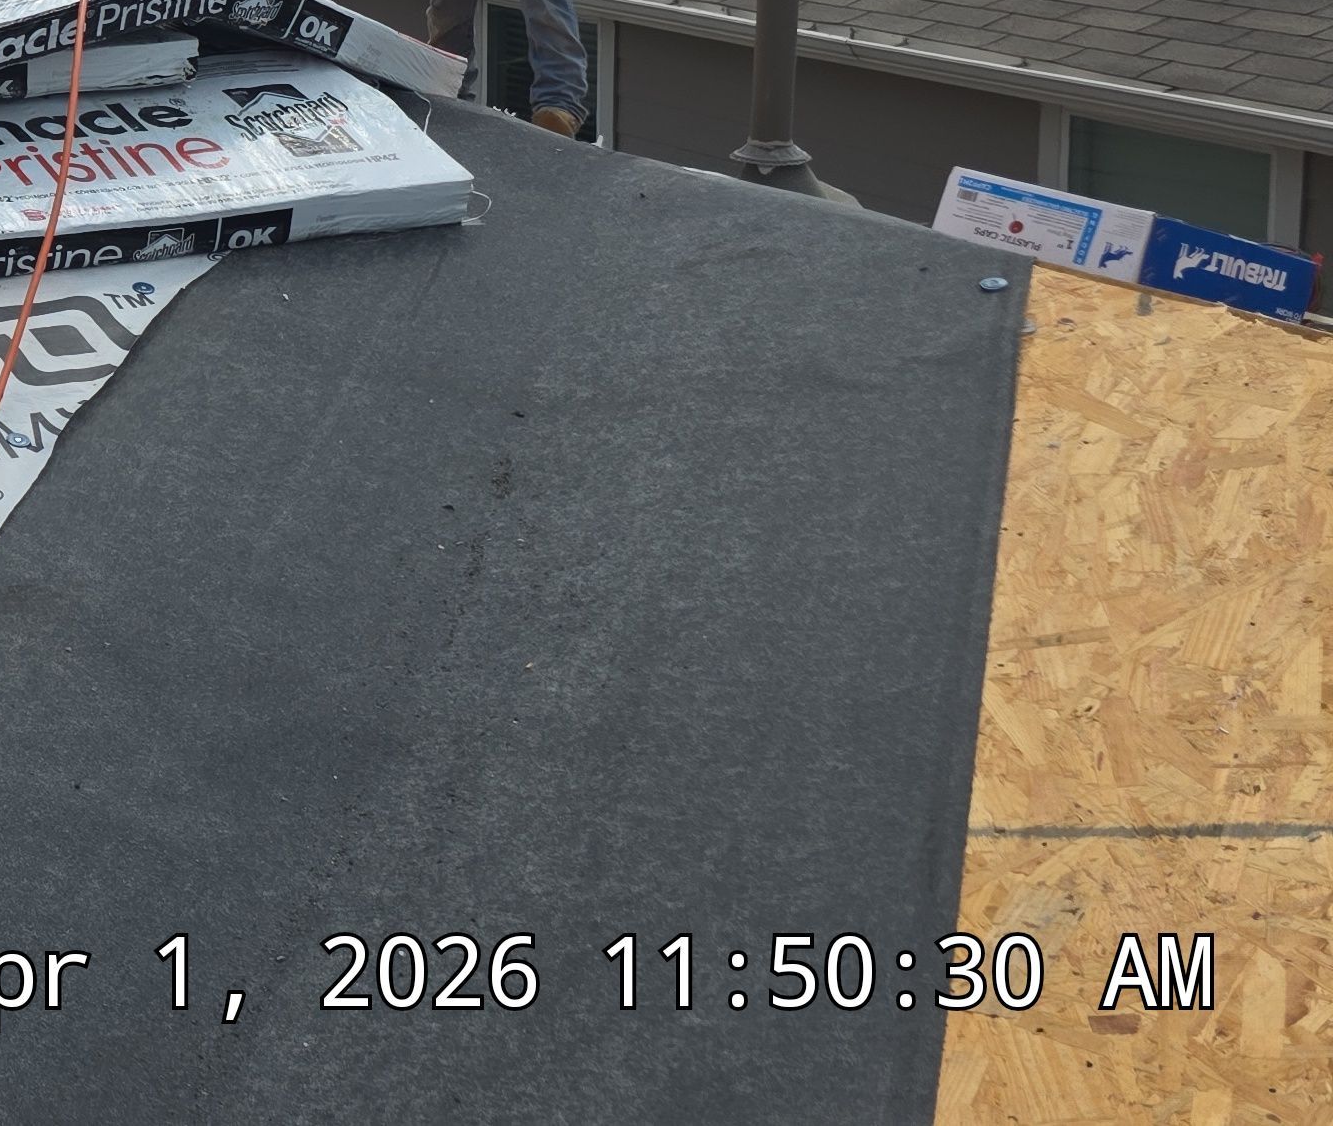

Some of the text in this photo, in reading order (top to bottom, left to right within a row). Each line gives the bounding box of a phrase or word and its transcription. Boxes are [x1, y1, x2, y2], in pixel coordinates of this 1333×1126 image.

[299, 15, 334, 47] OK
[224, 91, 350, 142] Scotchgard
[226, 225, 279, 250] OK
[973, 226, 1043, 252] PLASTIC CAPS
[1204, 251, 1288, 291] TRIBUILT
[103, 291, 156, 311] TM
